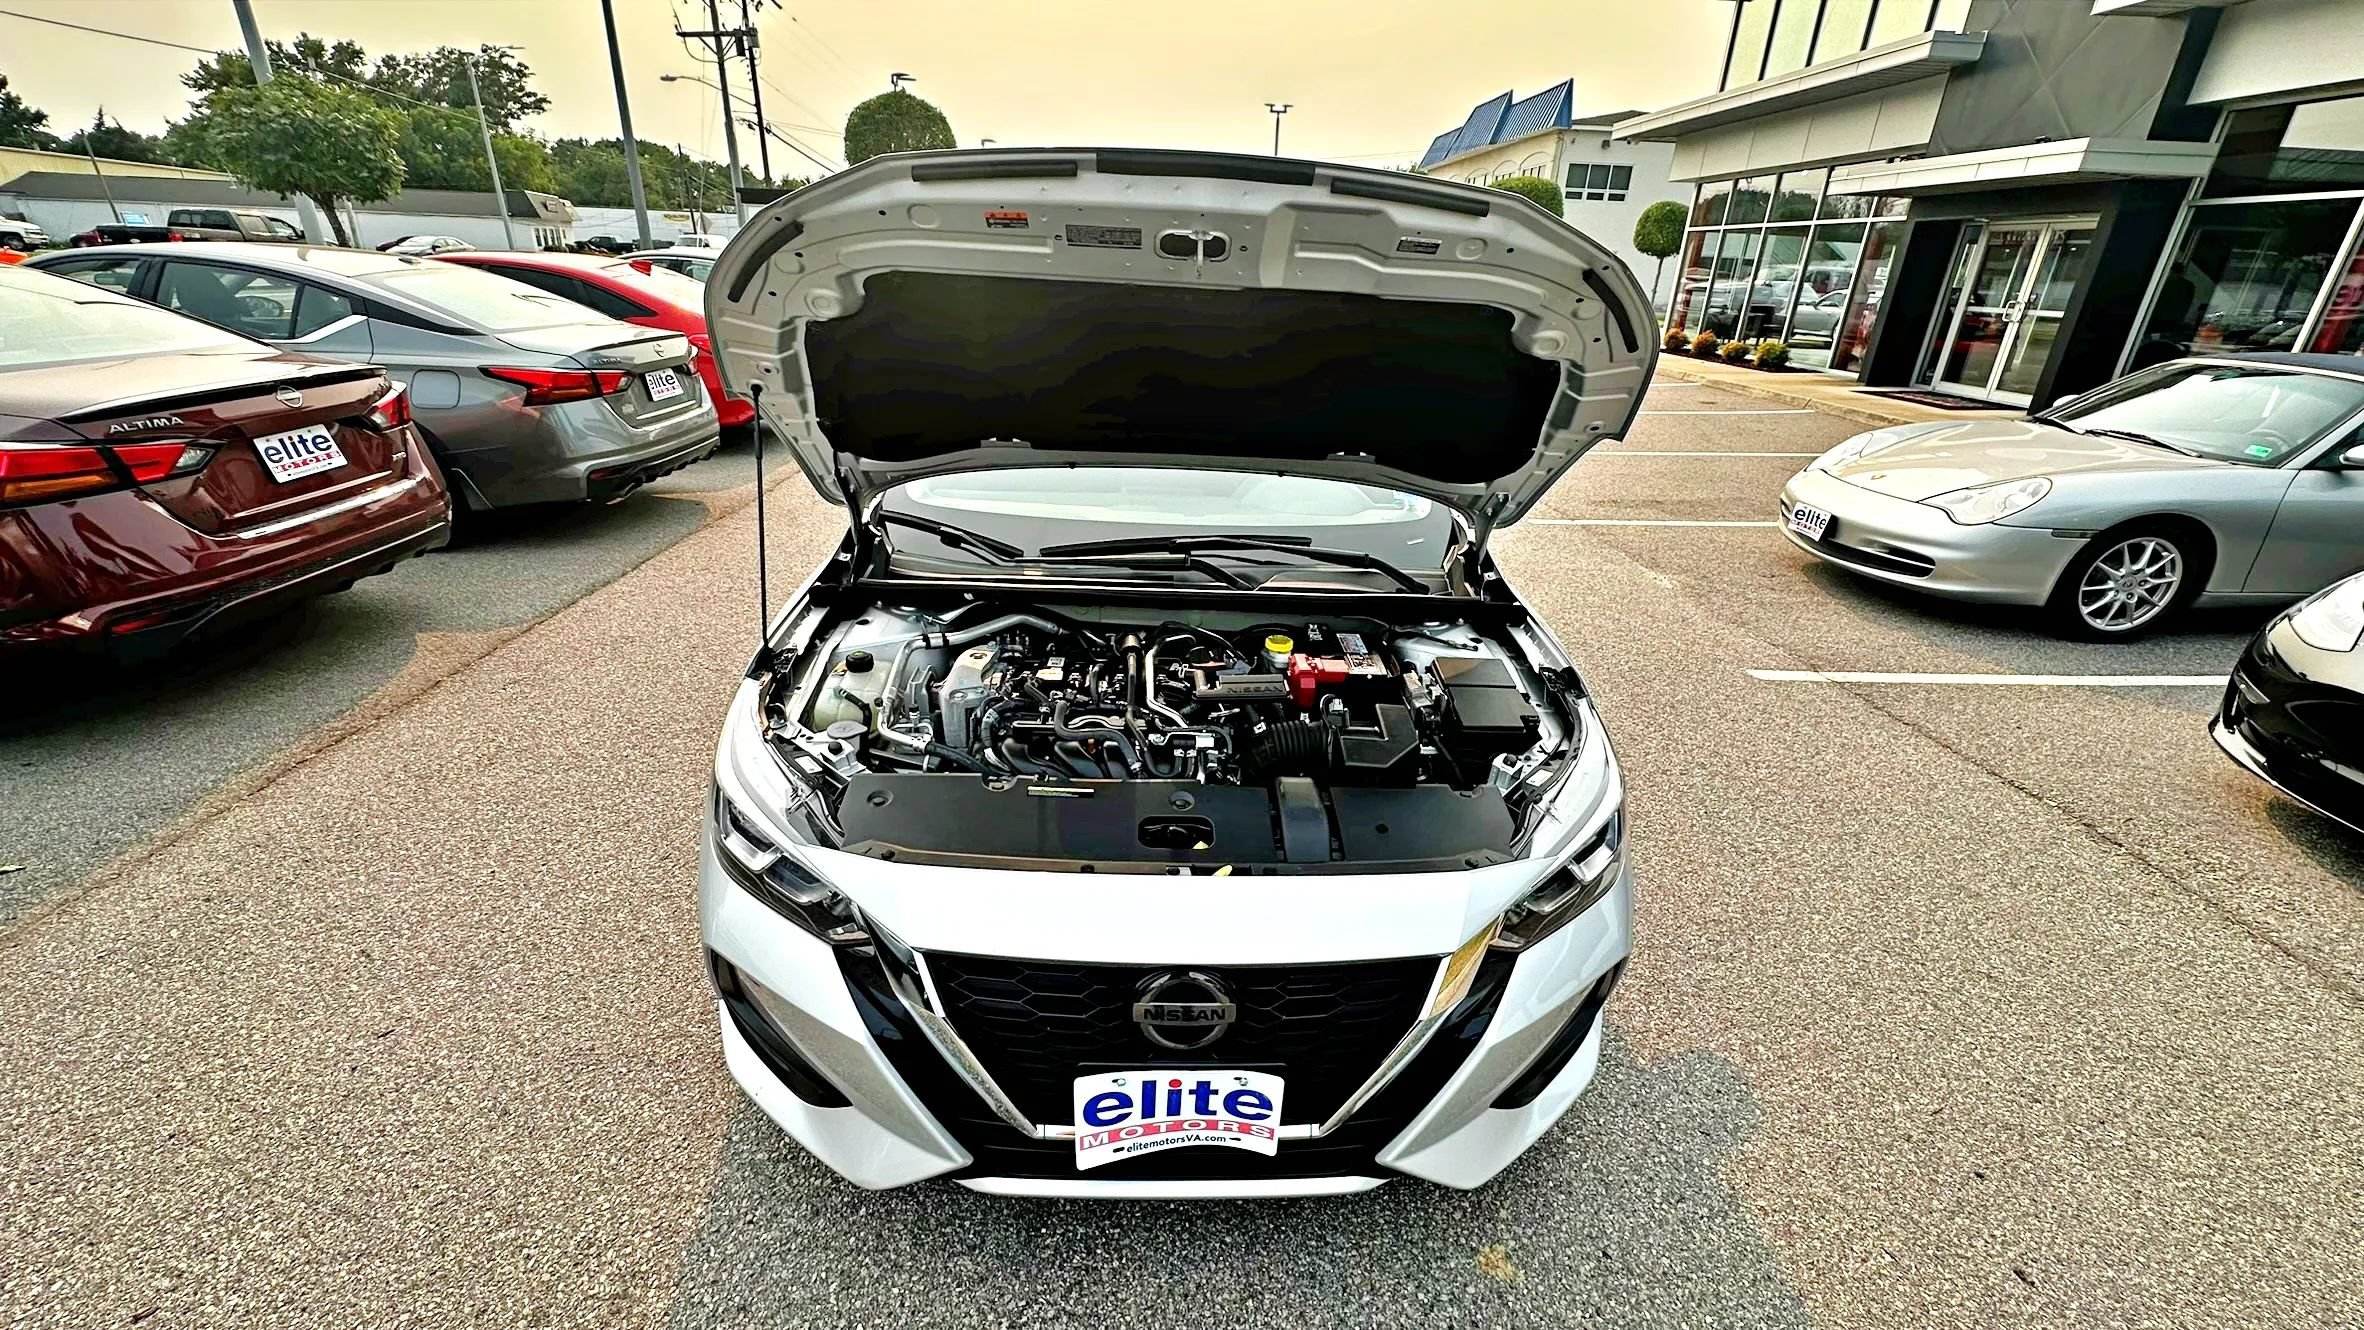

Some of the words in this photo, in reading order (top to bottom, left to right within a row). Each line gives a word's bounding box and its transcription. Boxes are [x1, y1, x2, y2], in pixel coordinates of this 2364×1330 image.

[648, 374, 676, 390] elite
[109, 416, 184, 434] ALTIMA
[264, 434, 332, 463] elite
[272, 451, 341, 474] MOTORS
[1794, 509, 1827, 529] elite
[1227, 686, 1283, 694] NISSAN
[1144, 1007, 1226, 1021] NISSAN
[1082, 1078, 1274, 1128] elite
[1081, 1119, 1273, 1150] MOTORS
[1126, 1134, 1227, 1153] elitemotorsVA.com
